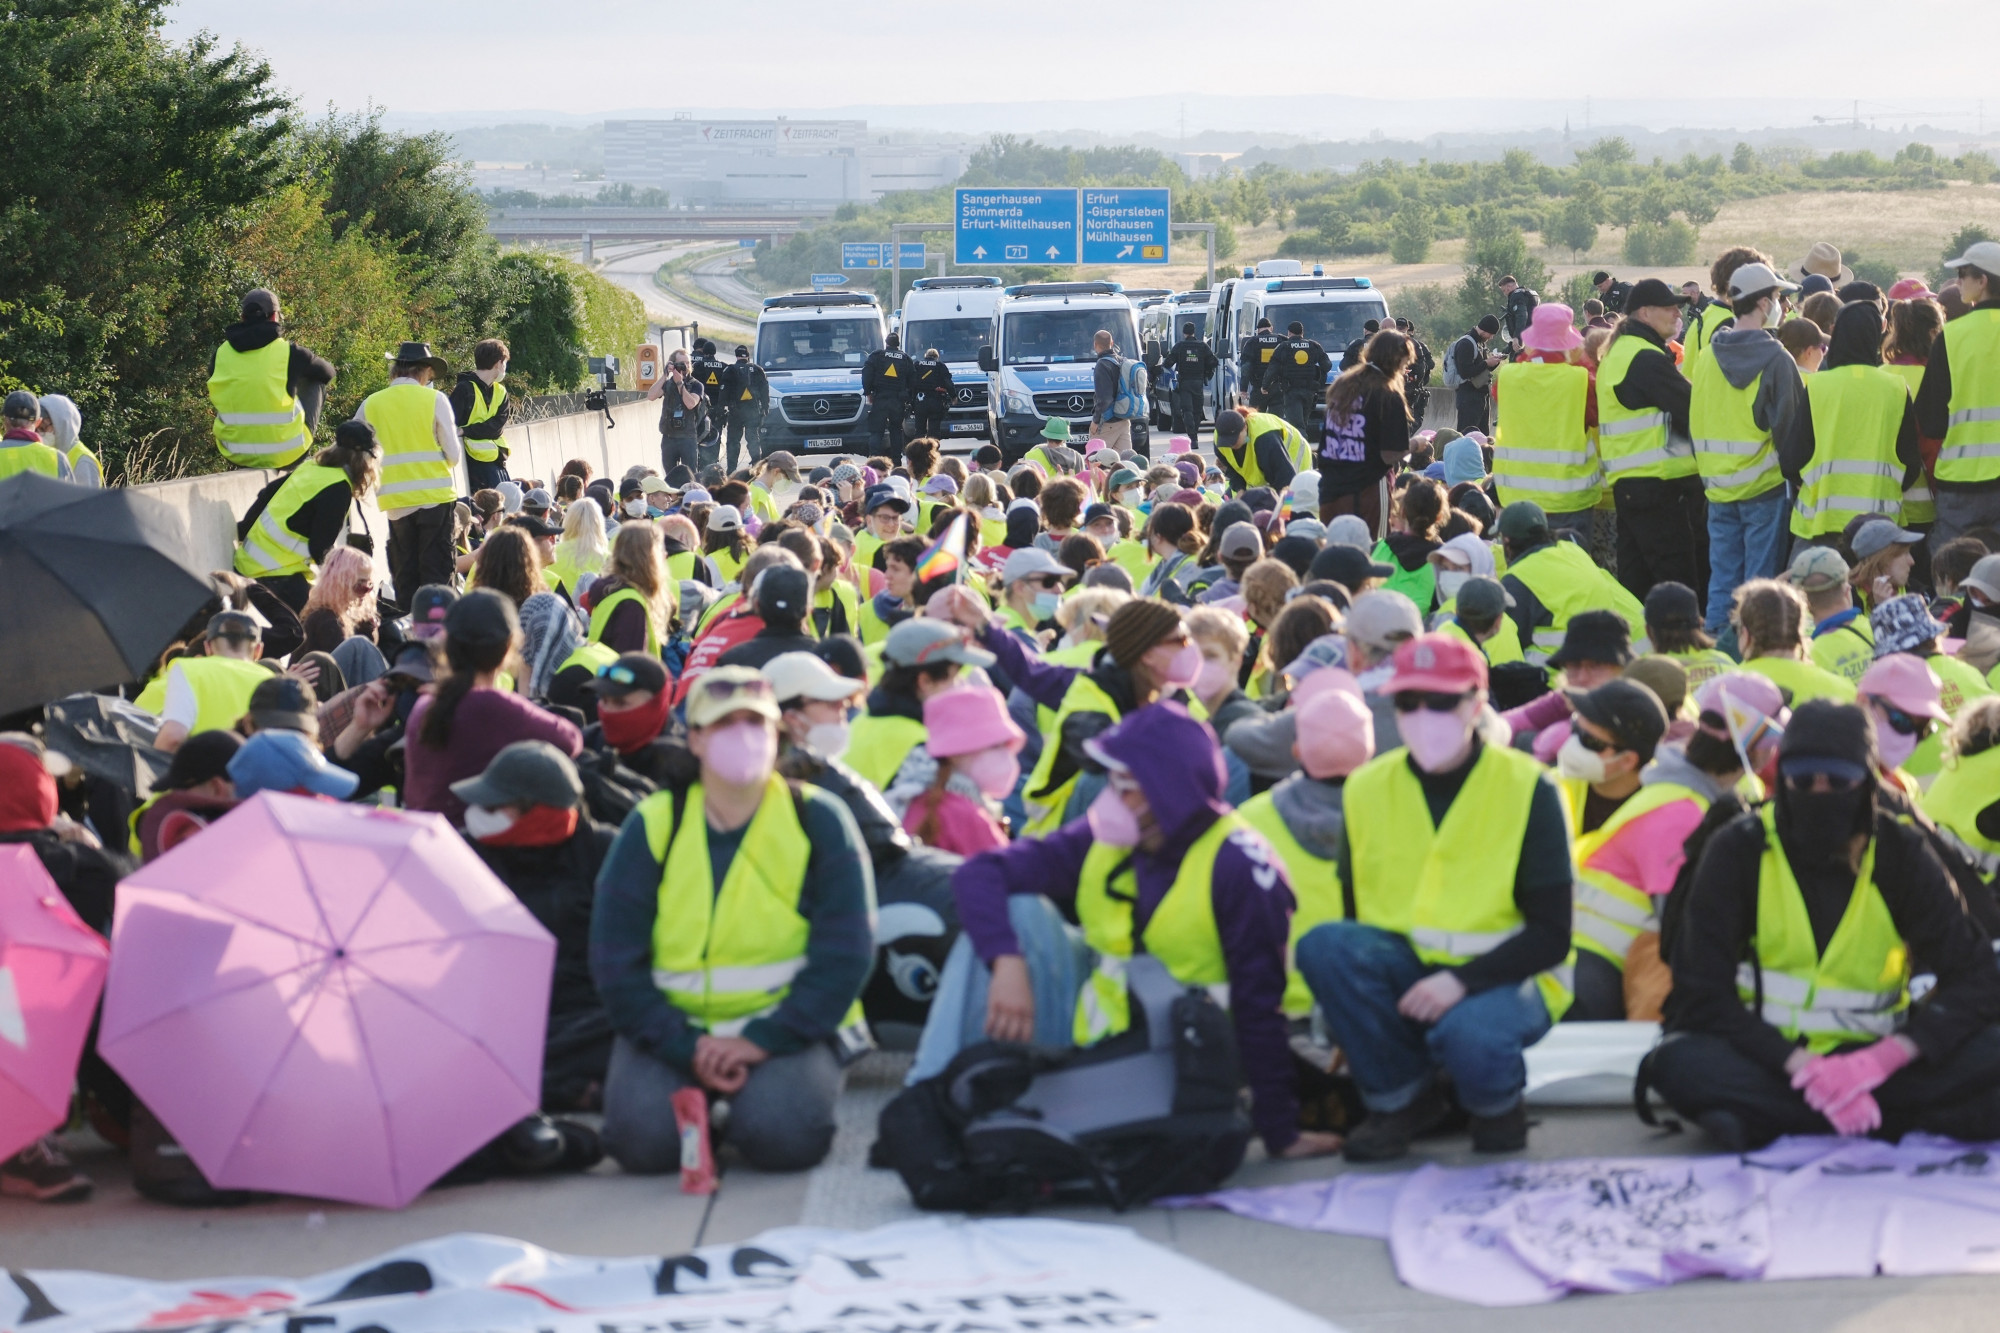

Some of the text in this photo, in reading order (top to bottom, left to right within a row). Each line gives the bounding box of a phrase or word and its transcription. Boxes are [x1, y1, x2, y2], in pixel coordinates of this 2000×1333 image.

[713, 128, 774, 140] ZEITFRACHT
[792, 128, 839, 140] ZEITFRACHT
[962, 193, 1042, 207] Sangerhausen
[1086, 193, 1119, 205] Erfurt
[962, 206, 1023, 218] Sömmerda
[1086, 206, 1165, 219] -Gispersleben
[961, 218, 1071, 230] Erfurt-Mittelhausen
[1086, 219, 1154, 230] Nordhausen
[1086, 231, 1153, 243] Mühlhausen
[1012, 247, 1022, 257] 71
[1149, 248, 1156, 257] 4
[885, 352, 903, 360] POLIZEI
[703, 361, 723, 369] POLIZEI
[793, 377, 851, 386] POLIZEI
